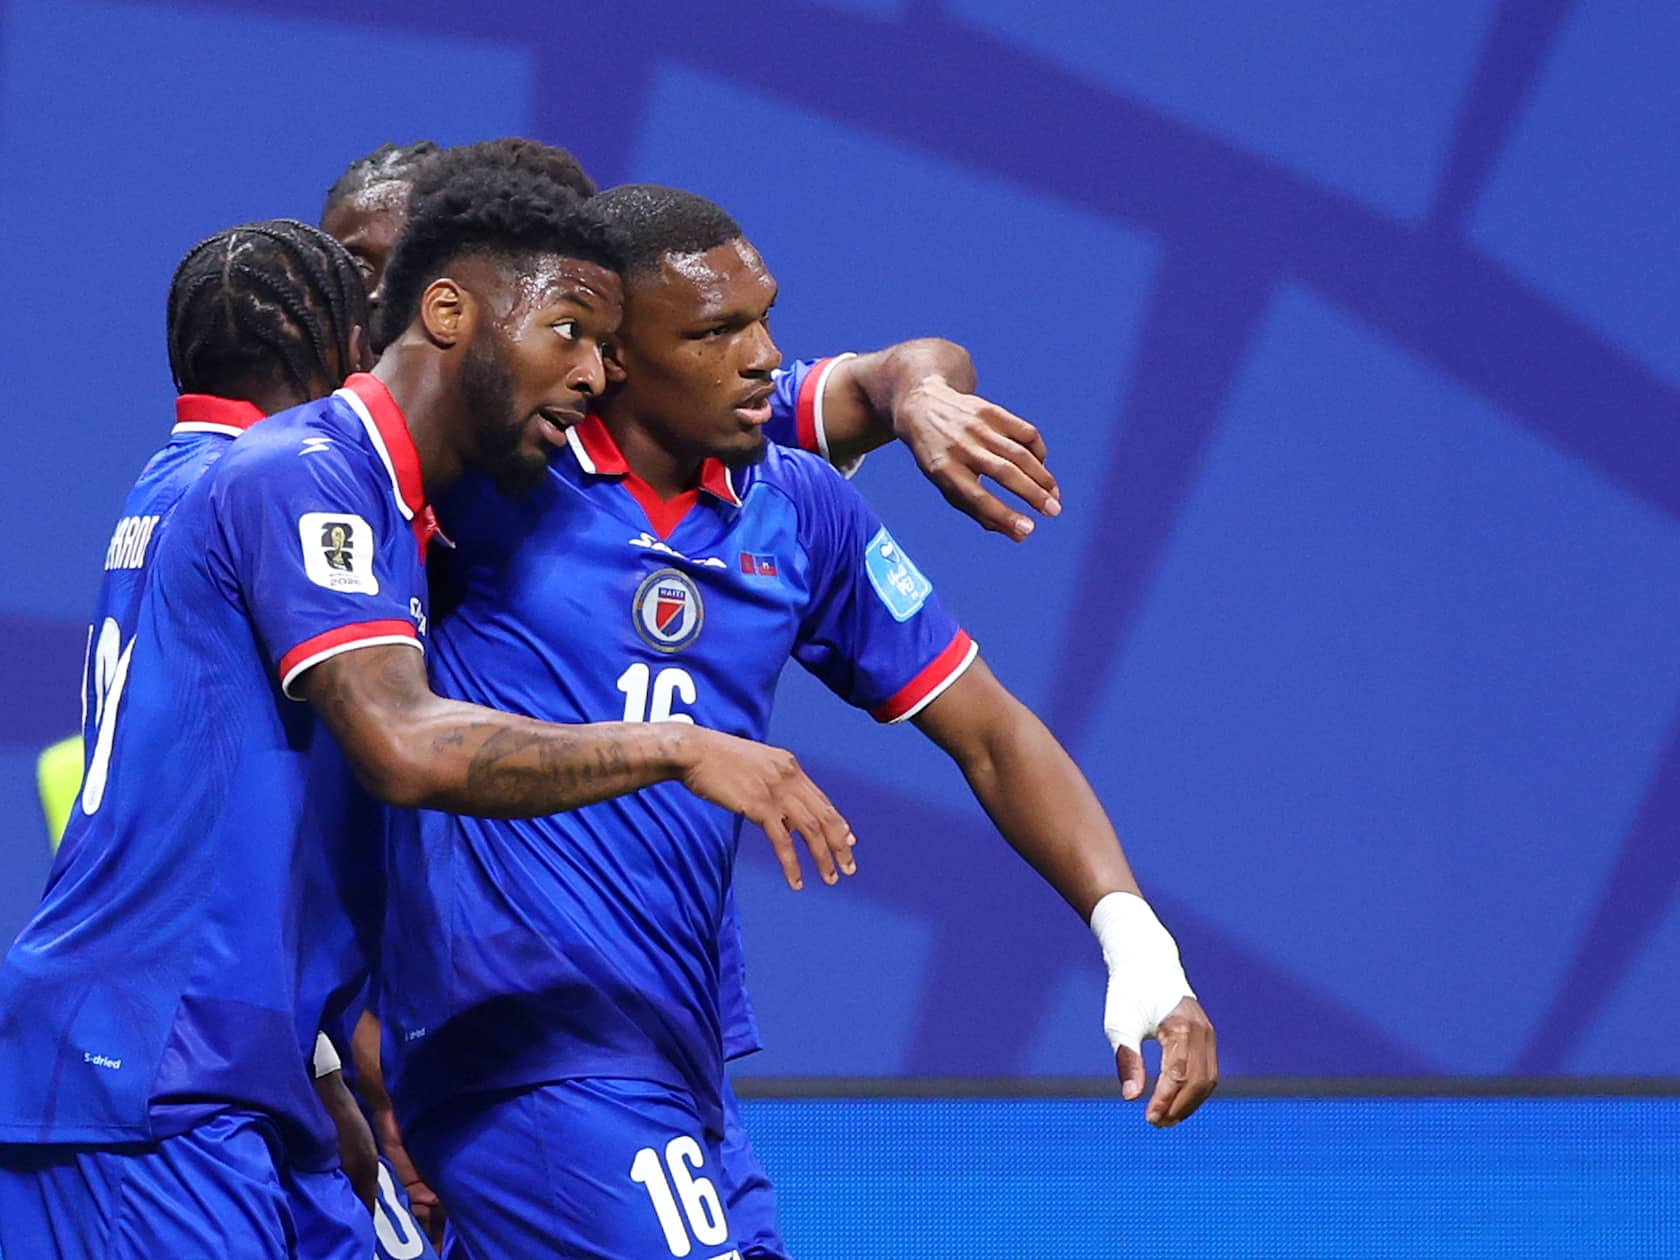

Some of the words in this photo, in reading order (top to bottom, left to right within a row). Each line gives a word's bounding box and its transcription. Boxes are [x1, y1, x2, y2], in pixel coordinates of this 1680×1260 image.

[616, 662, 697, 725] 16
[84, 1052, 122, 1070] S-dried
[630, 1135, 728, 1258] 16
